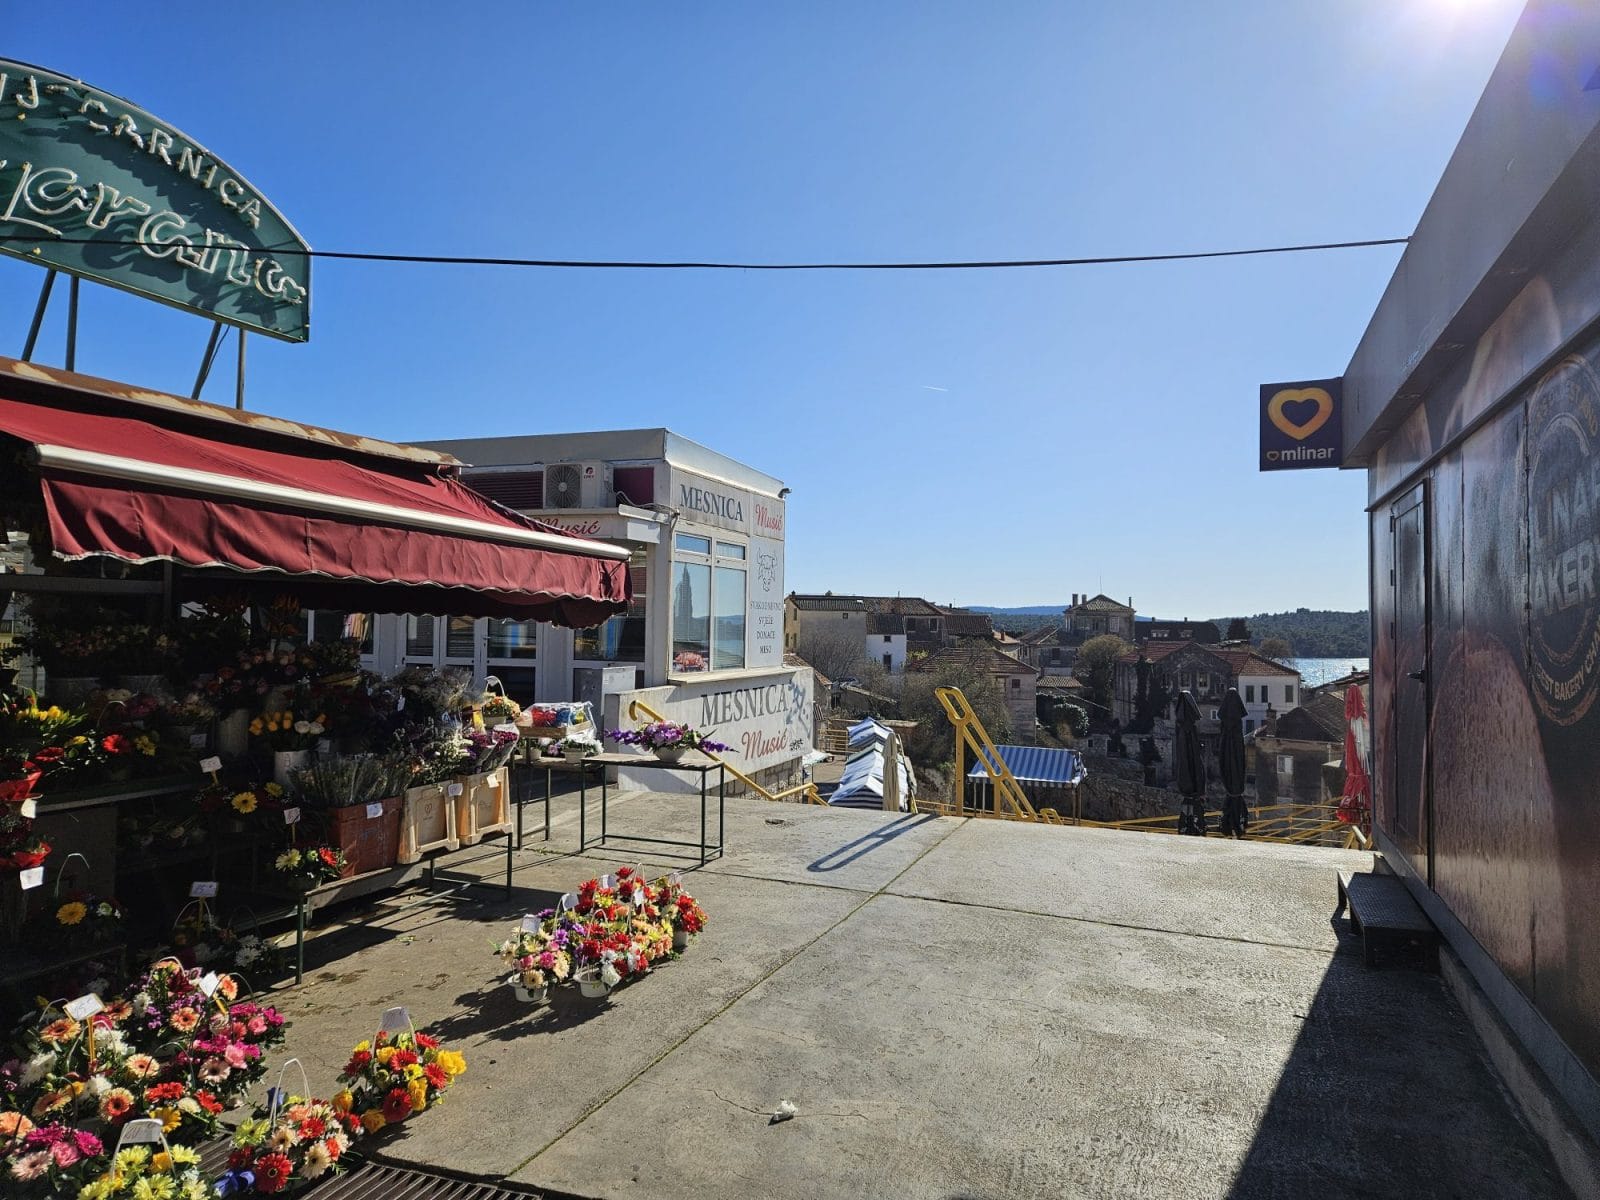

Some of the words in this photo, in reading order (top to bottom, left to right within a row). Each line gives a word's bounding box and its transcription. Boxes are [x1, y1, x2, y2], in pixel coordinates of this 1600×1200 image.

[1281, 446, 1335, 461] mlinar
[680, 484, 744, 522] MESNICA
[755, 503, 783, 532] Musić
[1554, 665, 1585, 701] BAKERY
[699, 684, 789, 728] MESNICA
[741, 728, 788, 761] Musić
